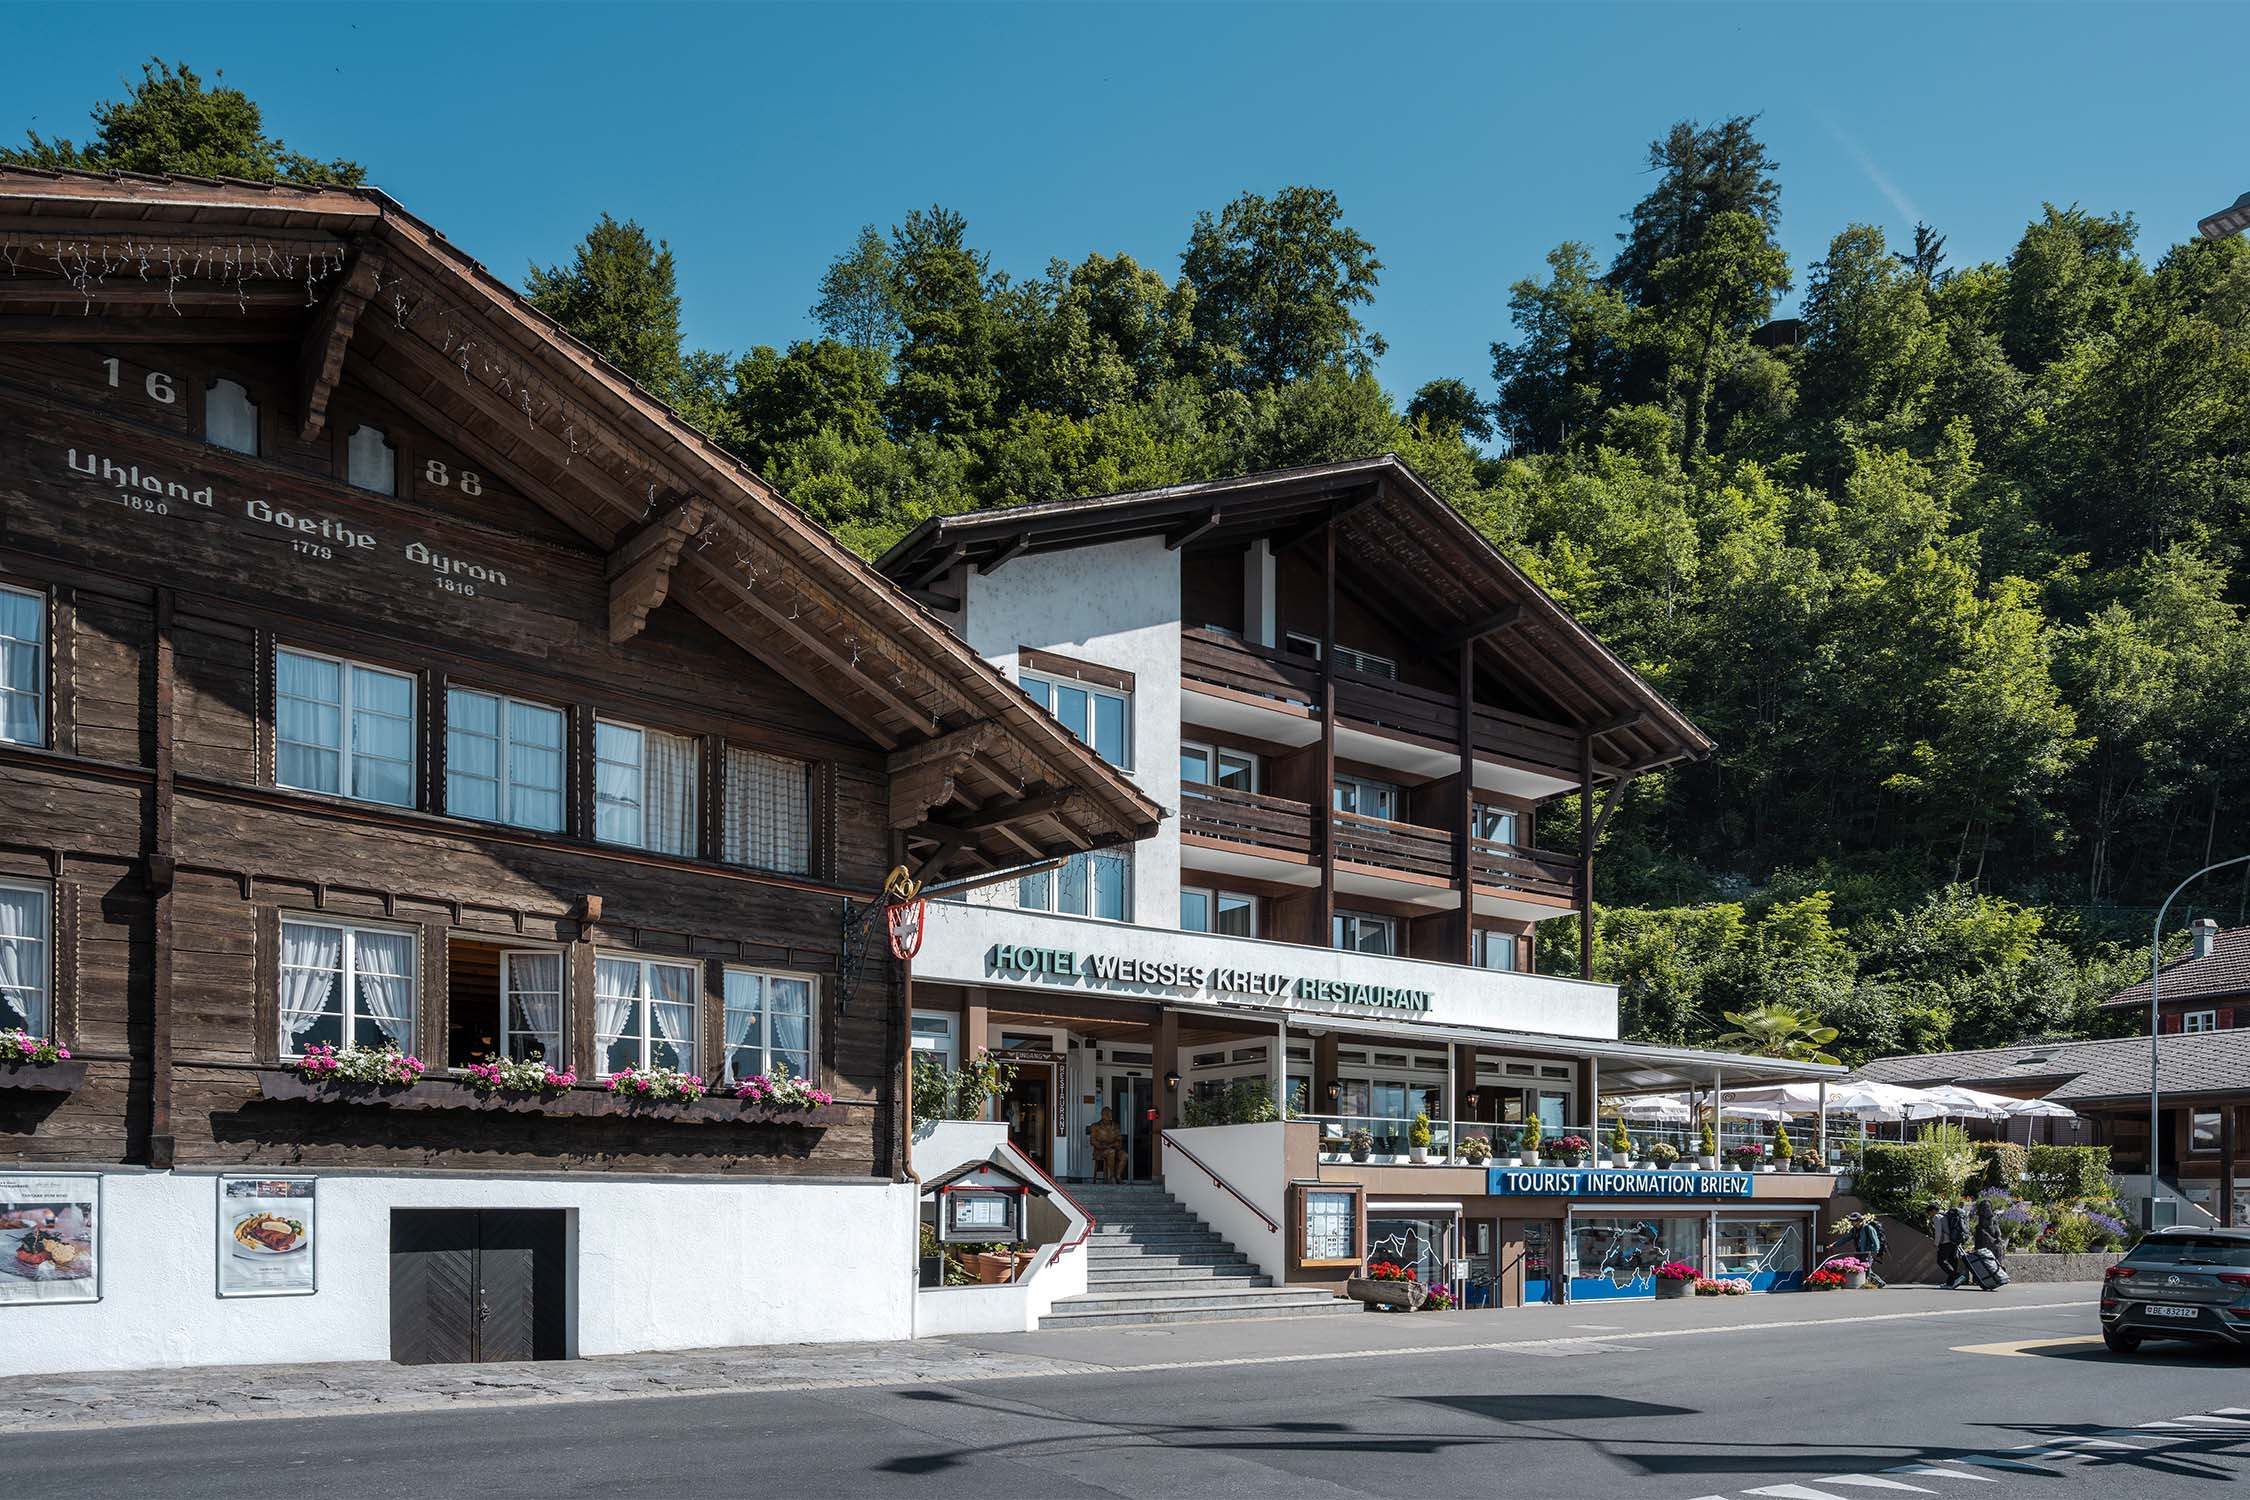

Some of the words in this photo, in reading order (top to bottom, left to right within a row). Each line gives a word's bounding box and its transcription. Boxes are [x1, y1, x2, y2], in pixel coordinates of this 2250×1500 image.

[68, 448, 213, 507] Uhland
[247, 500, 377, 550] Goethe
[405, 542, 507, 586] Byron
[120, 494, 168, 516] 1820
[435, 577, 475, 597] 1816
[996, 943, 1087, 976] HOTEL
[1092, 954, 1208, 989] WEISSES
[1216, 967, 1301, 997] KREUZ
[1301, 977, 1433, 1012] RESTAURANT
[1507, 1172, 1581, 1192] TOURIST
[1587, 1174, 1695, 1193] INFORMATION
[1701, 1176, 1749, 1194] BRIENZ
